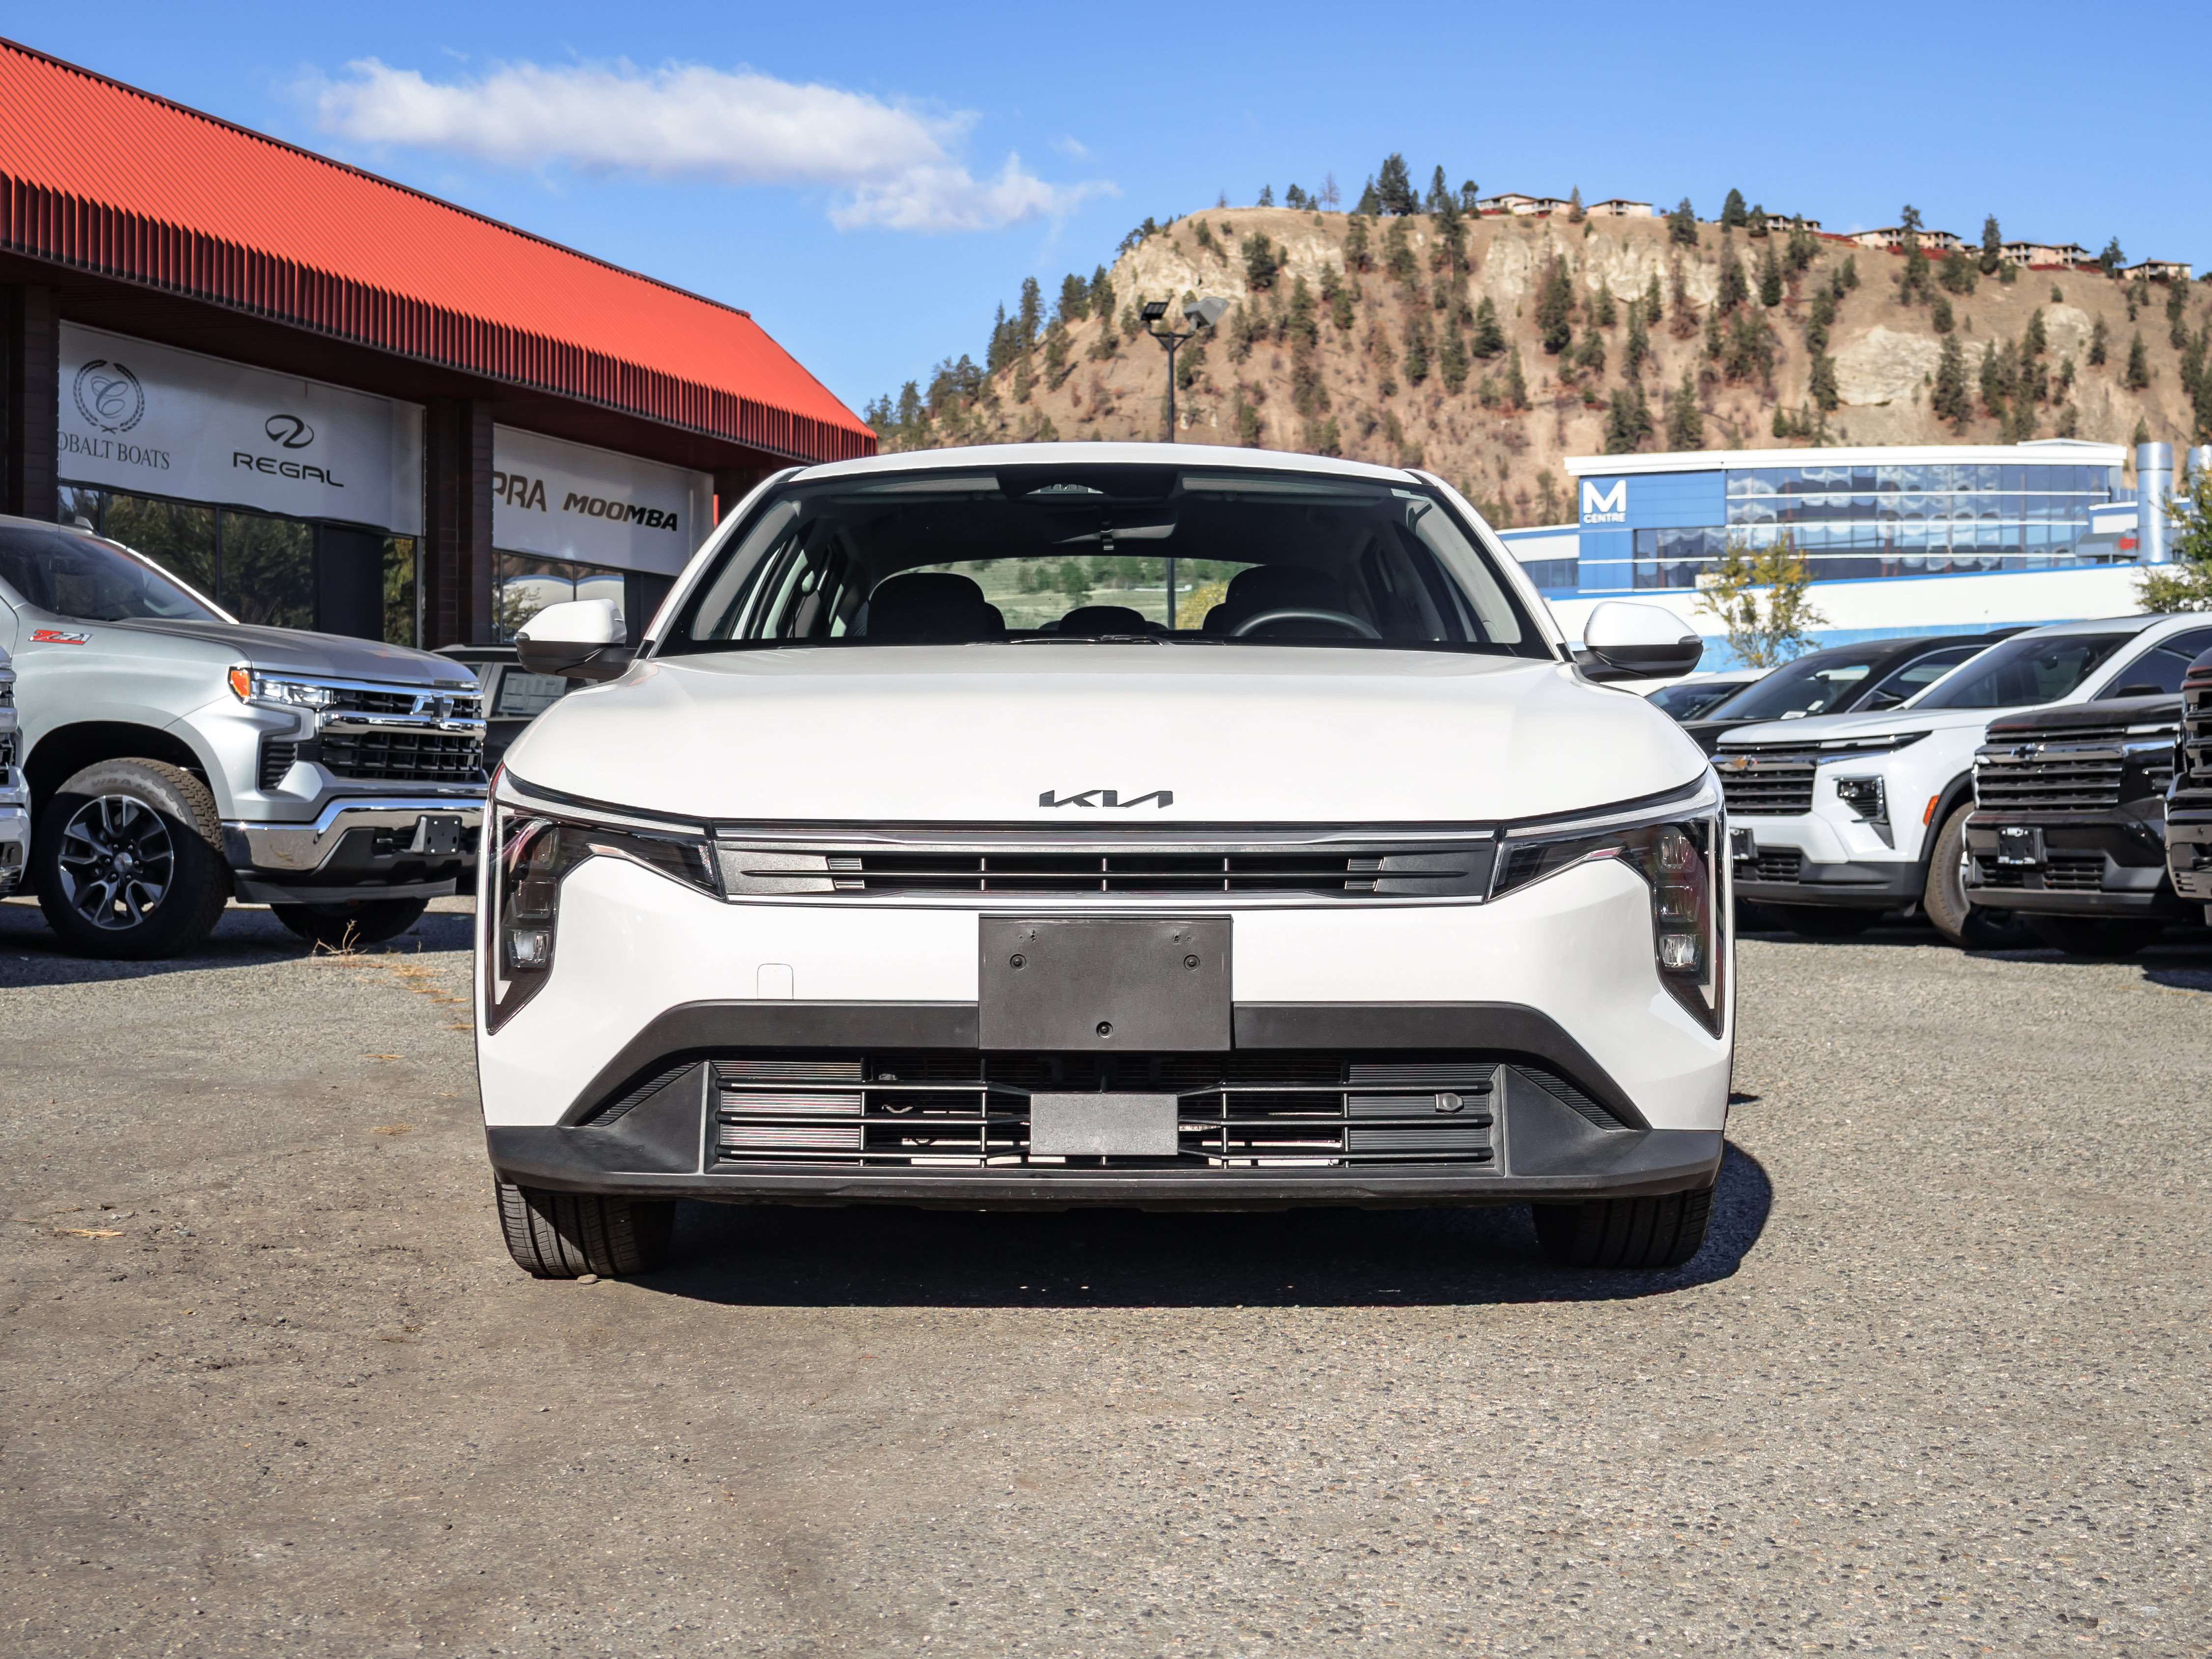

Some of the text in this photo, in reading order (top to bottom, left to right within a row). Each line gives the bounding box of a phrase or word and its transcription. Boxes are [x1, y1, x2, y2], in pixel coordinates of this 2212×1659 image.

[117, 442, 170, 470] BOATS
[233, 452, 344, 487] REGAL
[494, 471, 546, 512] PRA
[1583, 479, 1627, 514] M
[563, 493, 678, 531] MOOMBA
[1583, 512, 1626, 524] CENTRE
[28, 629, 93, 645] Z71
[1039, 790, 1173, 808] KIA
